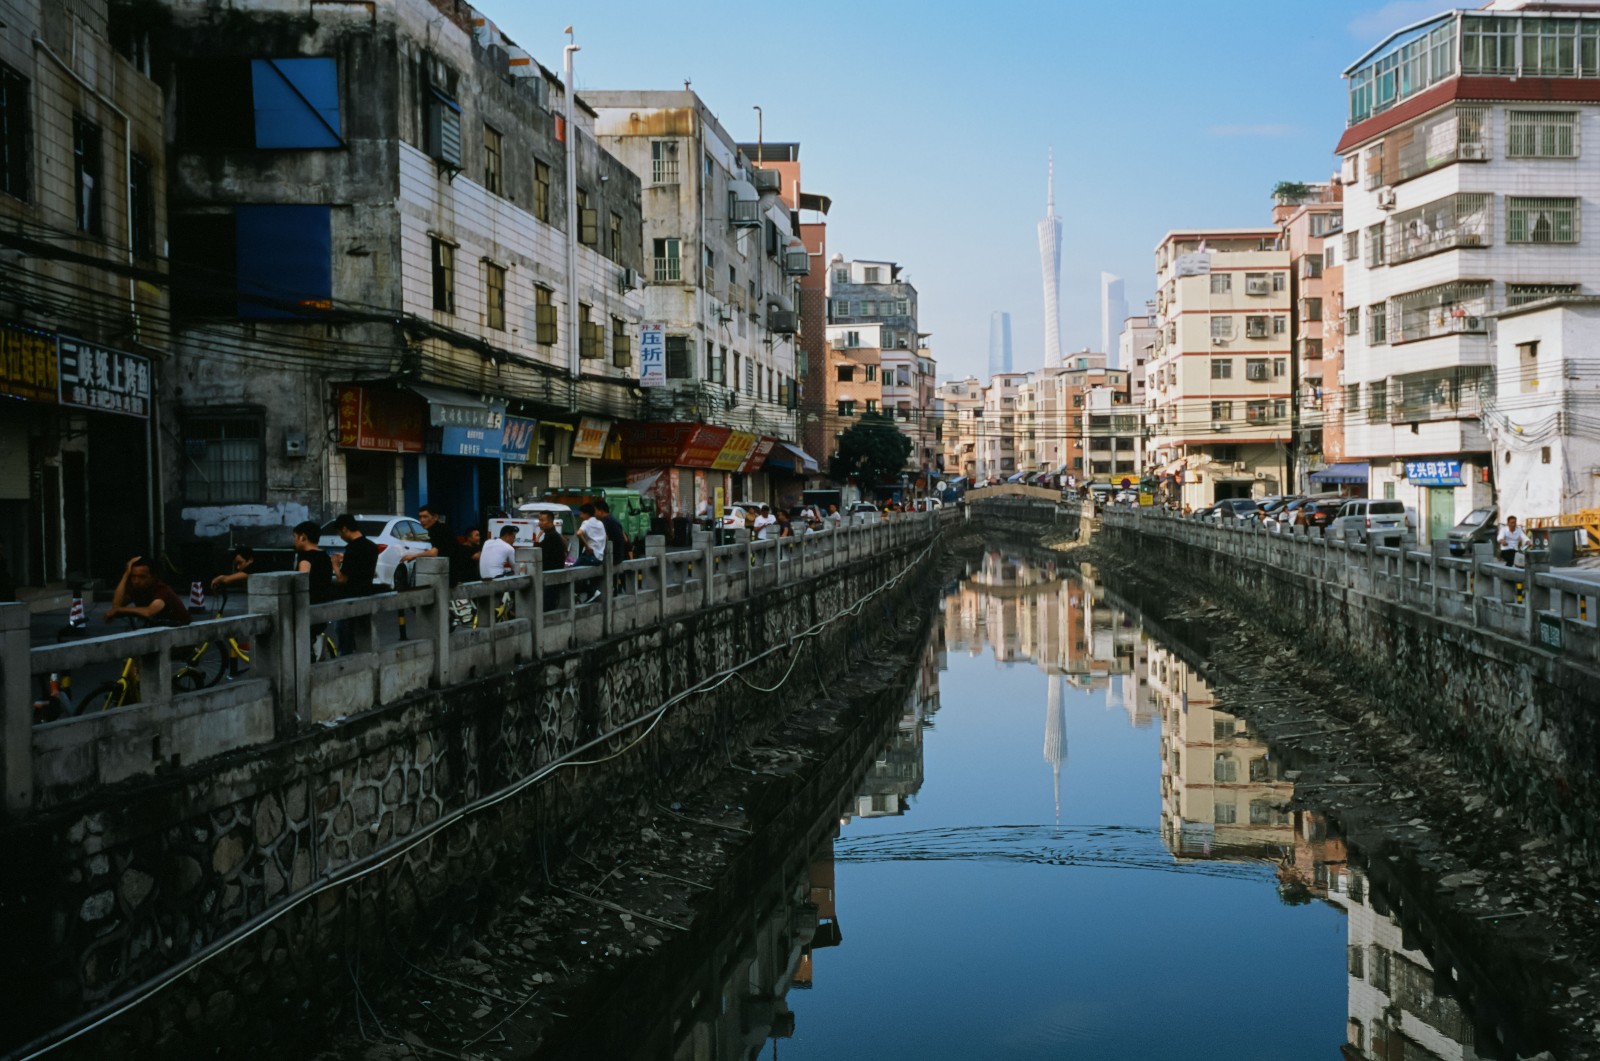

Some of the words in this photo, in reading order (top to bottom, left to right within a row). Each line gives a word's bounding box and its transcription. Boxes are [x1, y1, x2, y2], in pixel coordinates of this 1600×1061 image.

[641, 331, 662, 377] 压折厂
[1406, 461, 1457, 478] 艺兴印花厂
